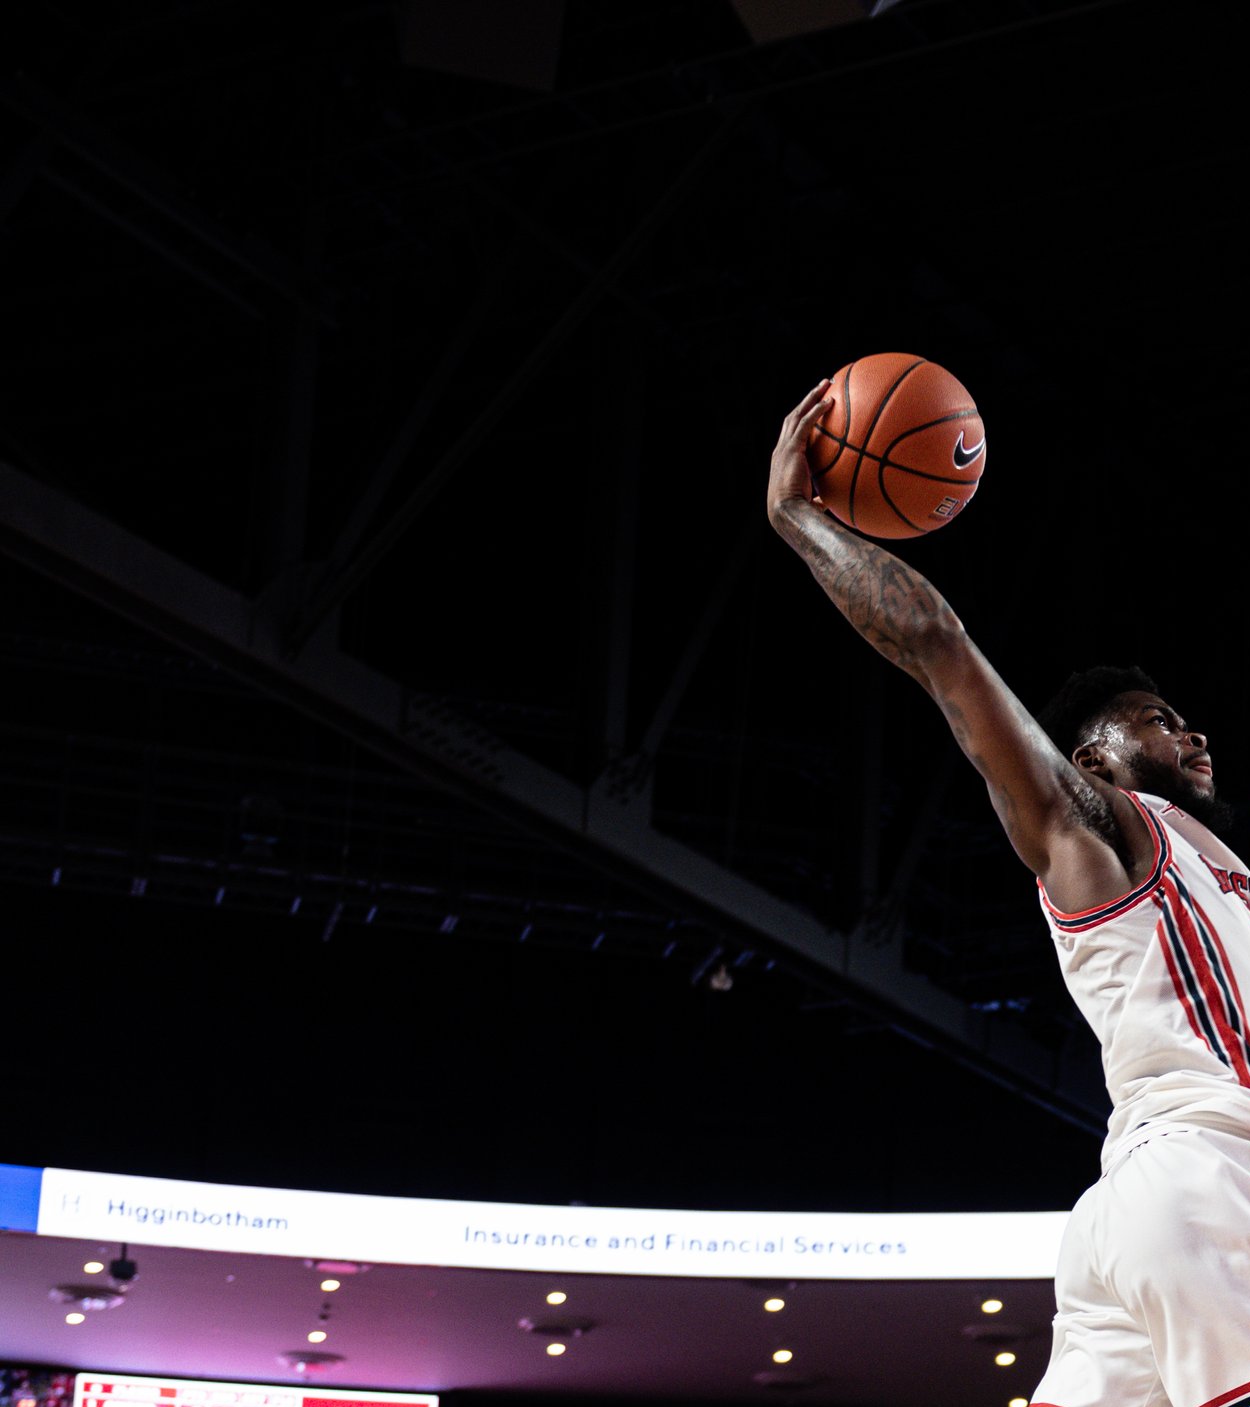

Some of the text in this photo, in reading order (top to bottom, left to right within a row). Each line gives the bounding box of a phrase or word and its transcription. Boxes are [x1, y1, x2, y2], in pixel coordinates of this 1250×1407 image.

[106, 1197, 289, 1232] Higginbotham
[464, 1225, 909, 1257] Insurance and Financial Services
